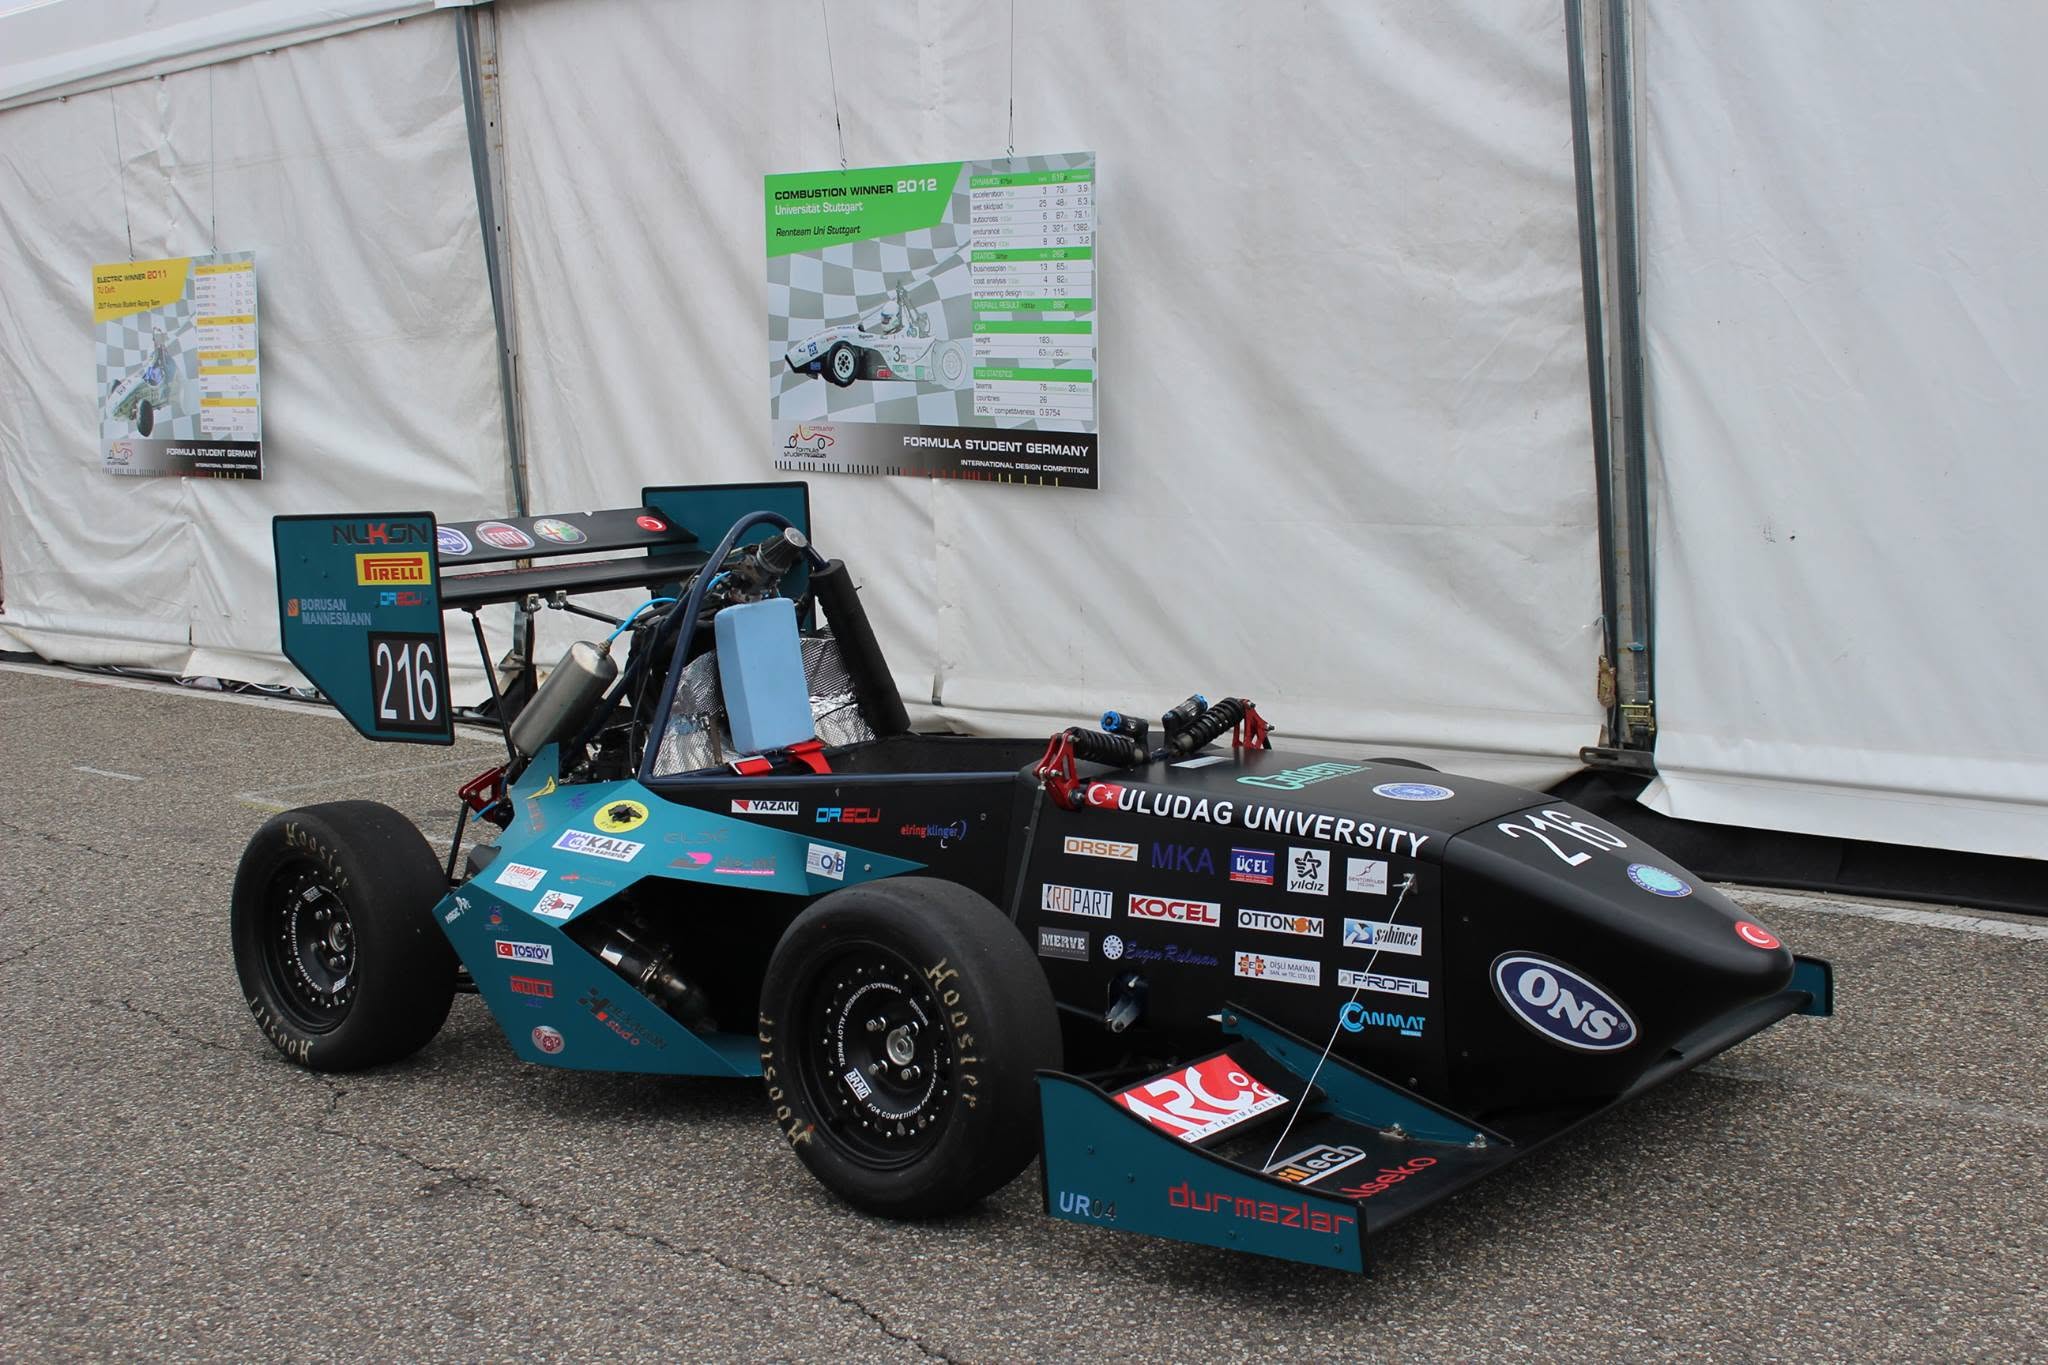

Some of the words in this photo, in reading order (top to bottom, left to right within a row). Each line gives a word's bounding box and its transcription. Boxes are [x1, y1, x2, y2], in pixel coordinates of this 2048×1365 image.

[775, 189, 847, 202] COMBUSTION
[848, 186, 894, 197] WINNER
[897, 179, 937, 193] 2012
[775, 203, 821, 216] Universität
[823, 202, 864, 215] Stuttgart
[776, 228, 812, 238] Rennteam
[814, 227, 826, 236] Uni
[827, 226, 861, 237] Stuttgart
[124, 273, 147, 281] WINNER
[147, 270, 167, 280] 2011
[166, 448, 197, 456] FORMULA
[197, 449, 226, 457] STUDENT
[227, 449, 257, 458] GERMANY
[903, 436, 962, 449] FORMULA
[965, 440, 1023, 453] STUDENT
[1026, 442, 1089, 457] GERMANY
[961, 460, 1014, 469] INTERNATIONAL
[1015, 464, 1042, 472] DESIGN
[1043, 465, 1090, 475] COMPETITION
[363, 557, 424, 581] PIRELLI
[302, 599, 347, 612] BORUSAN
[302, 612, 372, 626] MANNESMANN
[376, 643, 437, 721] 216
[752, 800, 798, 813] YAZAKI
[1117, 788, 1234, 826] ULUDAG
[1244, 805, 1429, 859] UNIVERSITY
[587, 837, 637, 855] KALE
[1497, 809, 1628, 868] 216
[1066, 839, 1134, 860] ORSEZ
[1151, 843, 1216, 876] MKA
[1046, 886, 1112, 917] KROPART
[512, 944, 551, 960] TOSYÖV
[1042, 933, 1085, 950] MERVE
[1518, 968, 1619, 1040] ONS
[837, 1015, 846, 1041] ALLOY
[837, 1041, 846, 1067] WHEEL
[846, 1070, 869, 1099] BRAID
[867, 1102, 881, 1115] FOR
[881, 1103, 921, 1120] COMPETITION
[1169, 1181, 1355, 1236] durmazlar
